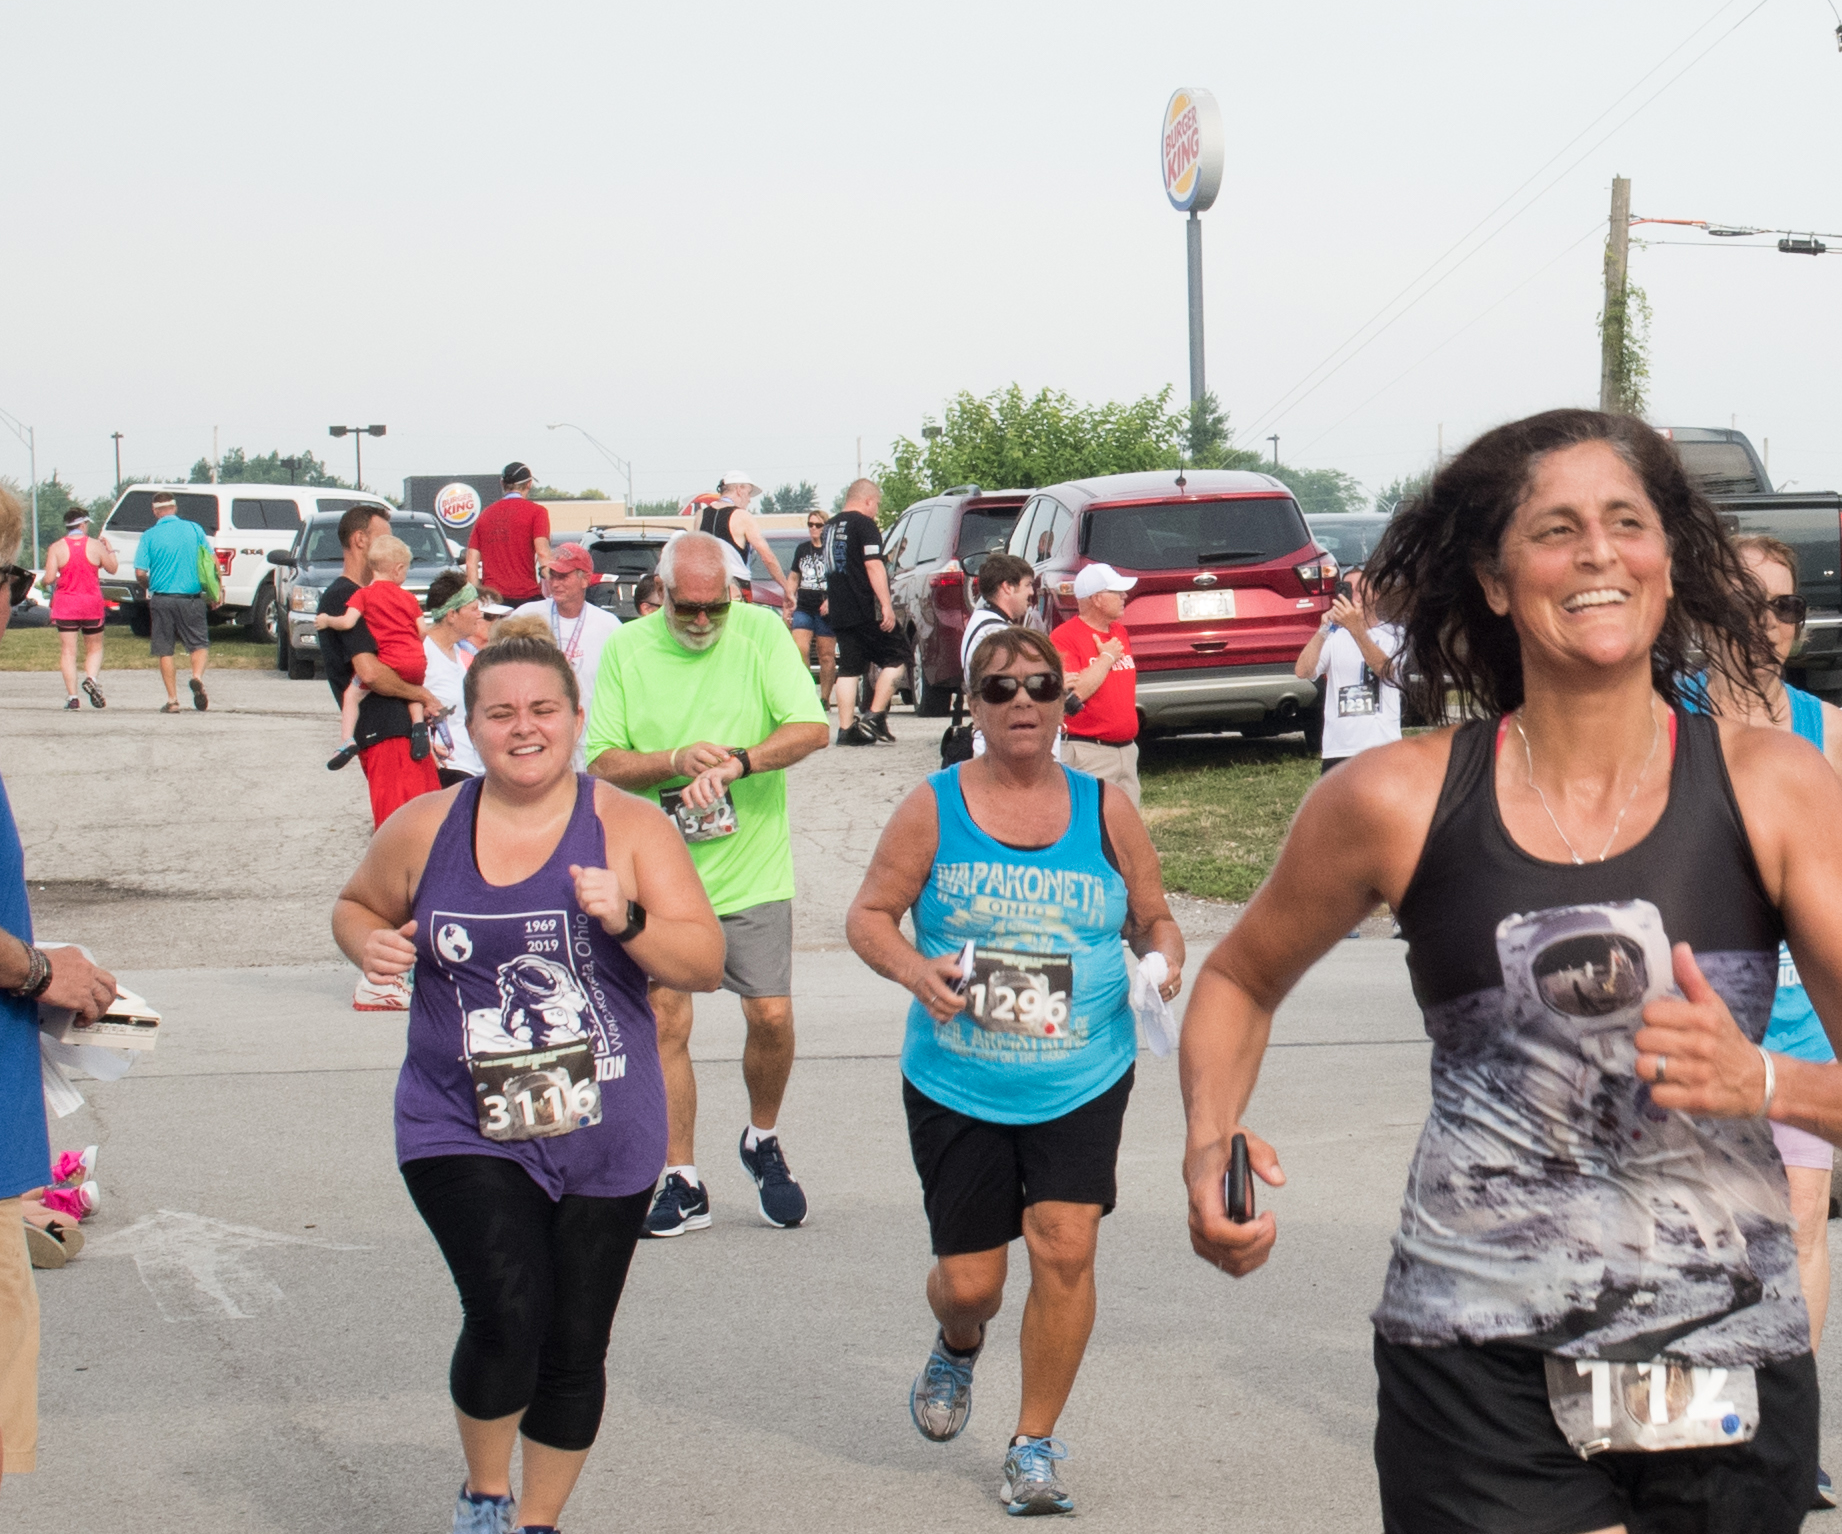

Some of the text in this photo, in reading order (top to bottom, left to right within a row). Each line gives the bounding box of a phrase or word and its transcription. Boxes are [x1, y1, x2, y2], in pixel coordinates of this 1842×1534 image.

[1165, 105, 1198, 159] BURGER
[1166, 126, 1200, 191] KING
[443, 499, 475, 518] KING
[1340, 697, 1373, 714] 1231
[937, 861, 1106, 928] WAPAKONETA
[989, 900, 1046, 917] OHIO
[525, 918, 557, 934] 1969
[527, 939, 559, 953] 2019
[574, 913, 592, 958] Ohio
[970, 983, 1068, 1023] 1296
[483, 1077, 597, 1131] 3116
